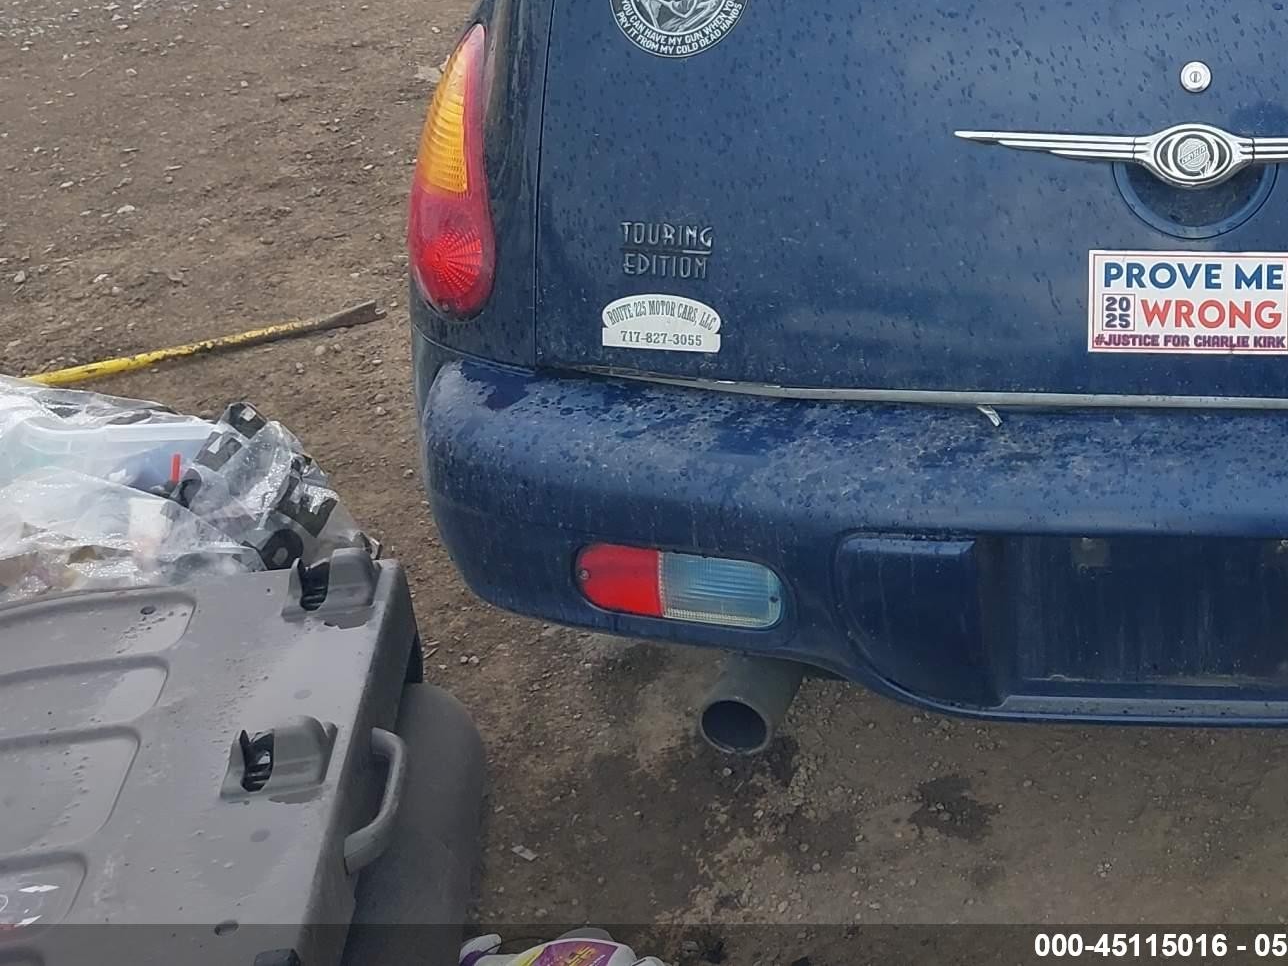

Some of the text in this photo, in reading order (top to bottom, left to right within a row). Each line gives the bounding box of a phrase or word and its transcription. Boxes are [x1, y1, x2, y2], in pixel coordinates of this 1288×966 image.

[616, 3, 743, 54] PRY IT FROM MY COLD DEAD HANDS
[630, 15, 645, 33] CAN
[644, 28, 666, 44] HAVE
[668, 36, 684, 44] MY
[685, 30, 703, 43] GUN
[703, 12, 727, 35] WHEN
[621, 222, 712, 248] TOURING
[623, 253, 708, 279] EDITION
[1104, 263, 1283, 290] PROVE ME
[606, 300, 716, 330] ROUTE 225 MOTOR CARS, LLC
[1105, 296, 1131, 312] 20
[1141, 299, 1282, 329] WRONG
[1105, 312, 1131, 329] 25
[621, 330, 702, 346] 717-827-3055
[1095, 333, 1286, 348] #JUSTICE FOR CHARLIE KIRK
